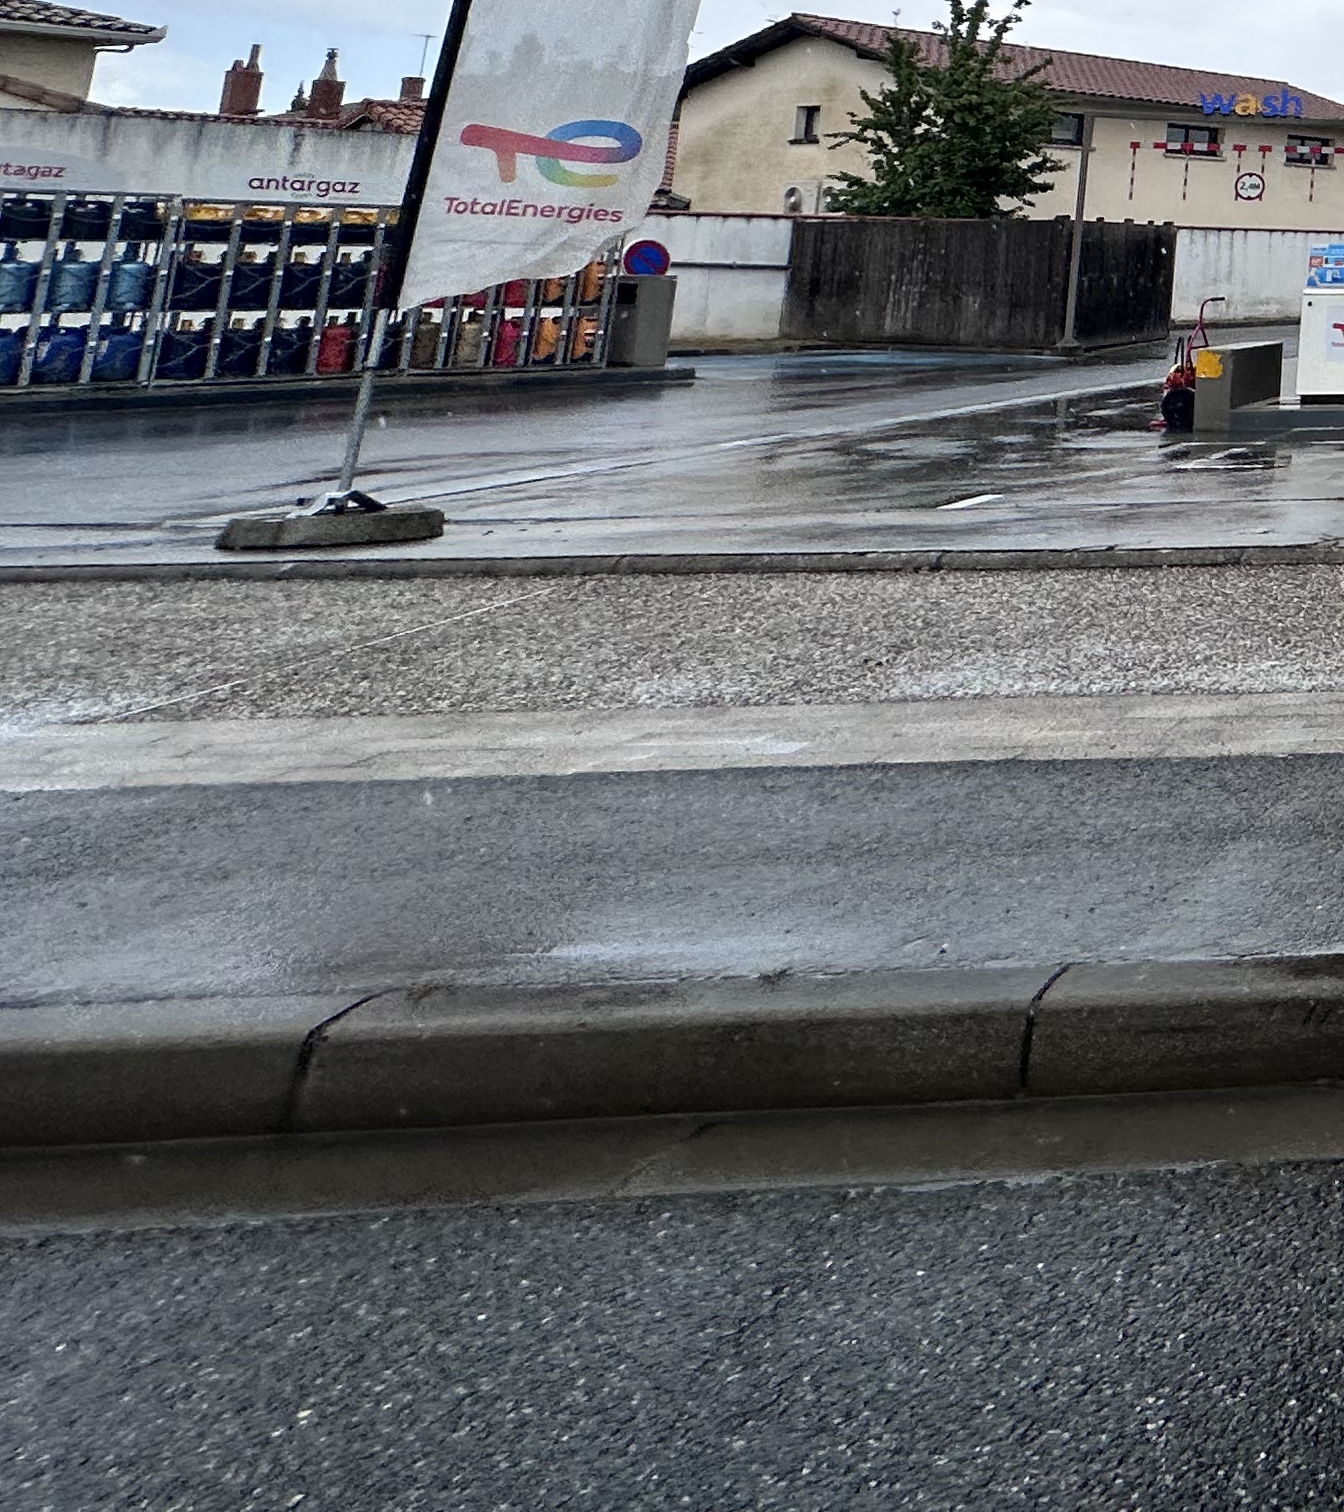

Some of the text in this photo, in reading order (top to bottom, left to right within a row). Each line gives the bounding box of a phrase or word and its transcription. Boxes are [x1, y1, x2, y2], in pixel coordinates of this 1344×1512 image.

[1200, 89, 1303, 117] wash
[0, 162, 66, 180] tagaz
[248, 176, 360, 198] antargaz
[444, 196, 624, 224] TotalEnergies
